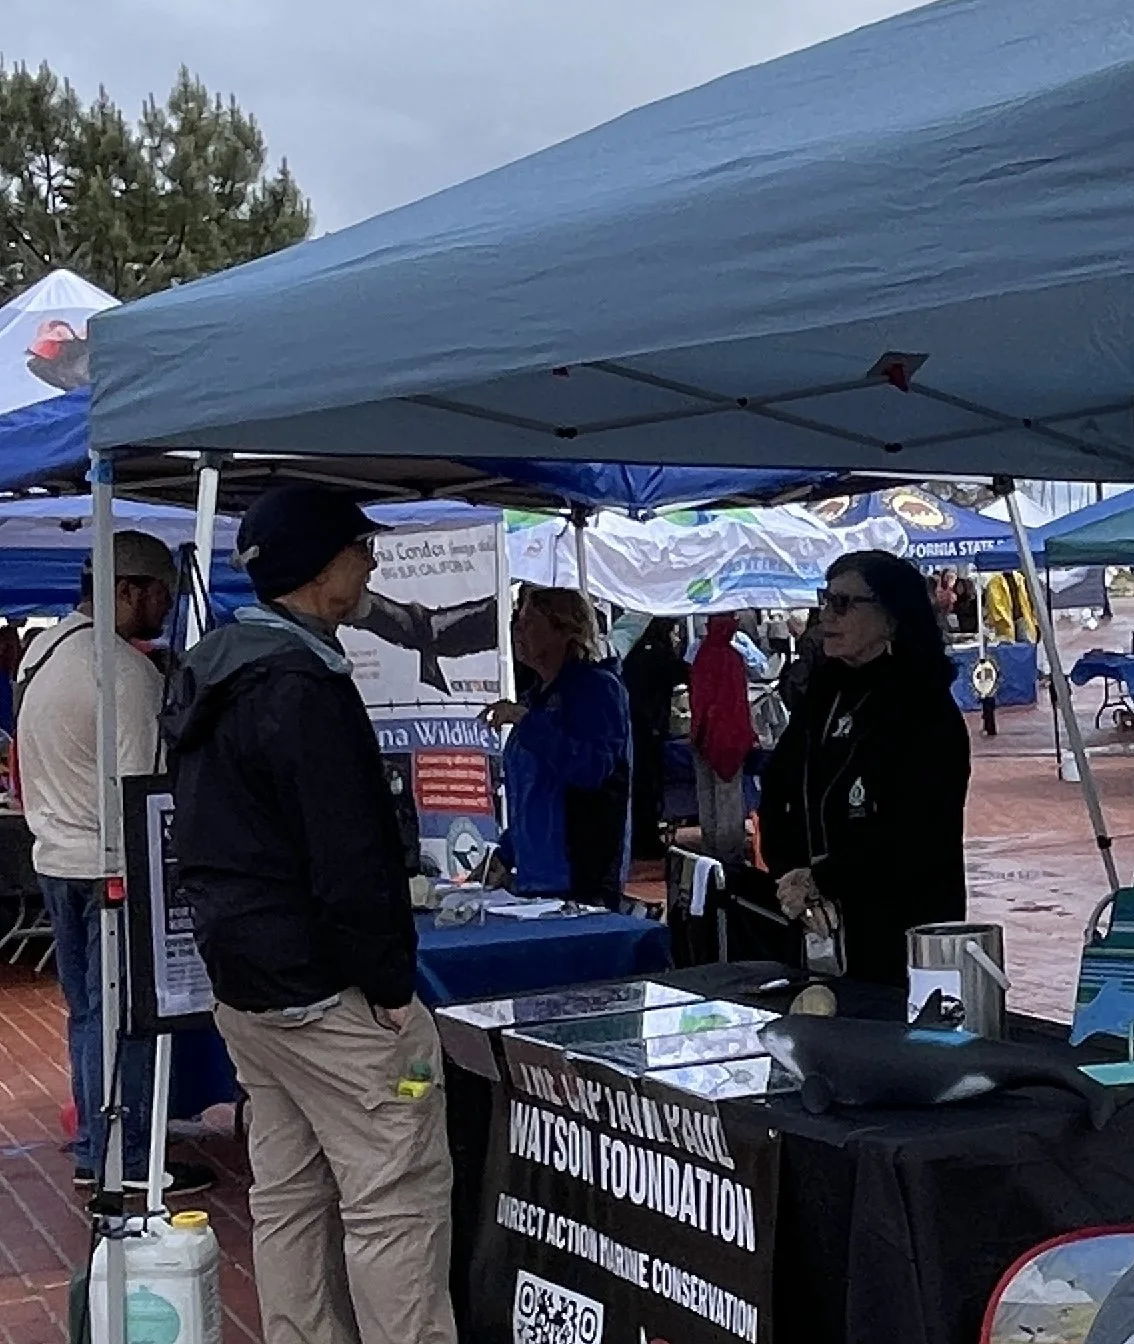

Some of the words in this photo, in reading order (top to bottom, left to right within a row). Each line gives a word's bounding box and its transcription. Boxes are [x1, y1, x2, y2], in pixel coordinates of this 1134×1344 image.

[906, 541, 958, 558] FORNIA
[561, 1072, 668, 1143] CAPTAIN
[663, 1102, 736, 1171] PAUL
[509, 1098, 594, 1186] WATSON
[599, 1132, 756, 1253] FOUNDATION
[497, 1192, 546, 1241] DIRECT
[545, 1212, 598, 1264] ACTION
[599, 1232, 650, 1290] MARINE
